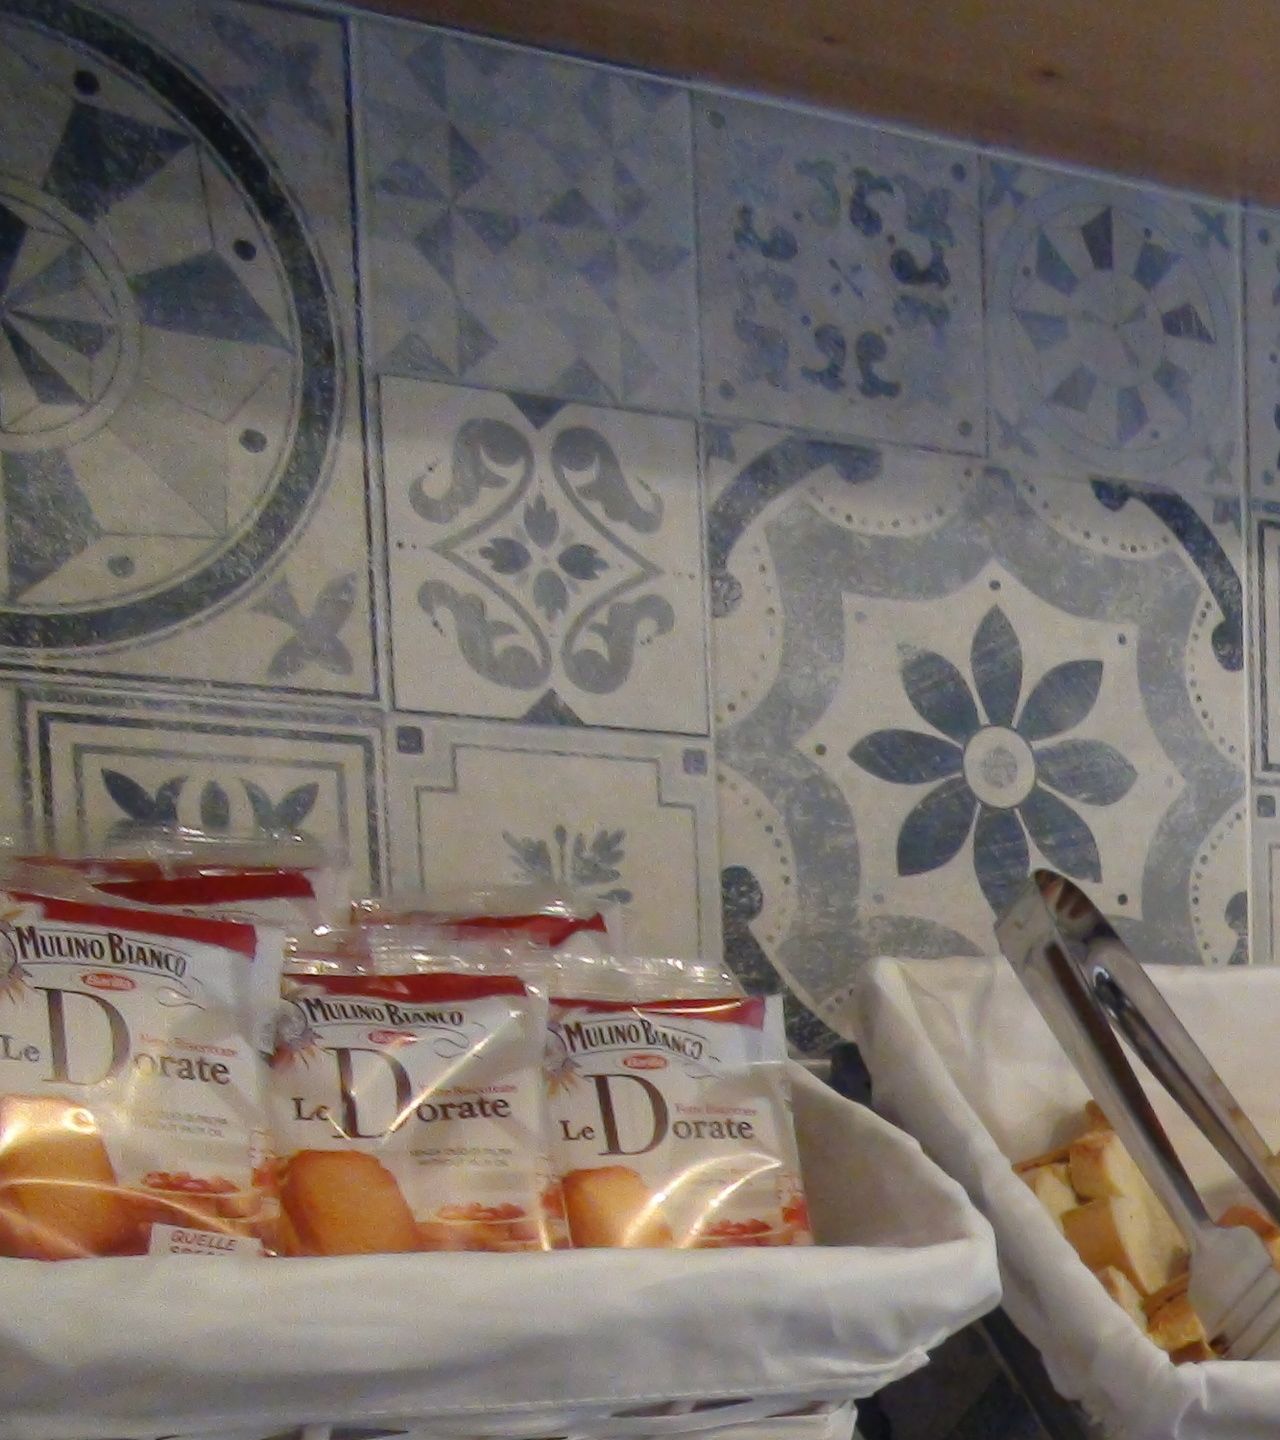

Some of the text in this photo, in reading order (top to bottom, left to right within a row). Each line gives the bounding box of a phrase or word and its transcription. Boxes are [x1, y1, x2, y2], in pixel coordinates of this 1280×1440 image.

[15, 925, 188, 978] MULINO BIANCO
[304, 998, 465, 1026] MULINO BIANCO
[0, 1034, 41, 1063] Le
[565, 1019, 703, 1060] MULINO BIANCO
[291, 1047, 513, 1139] Le Dorate
[559, 1073, 755, 1156] Le Dorate
